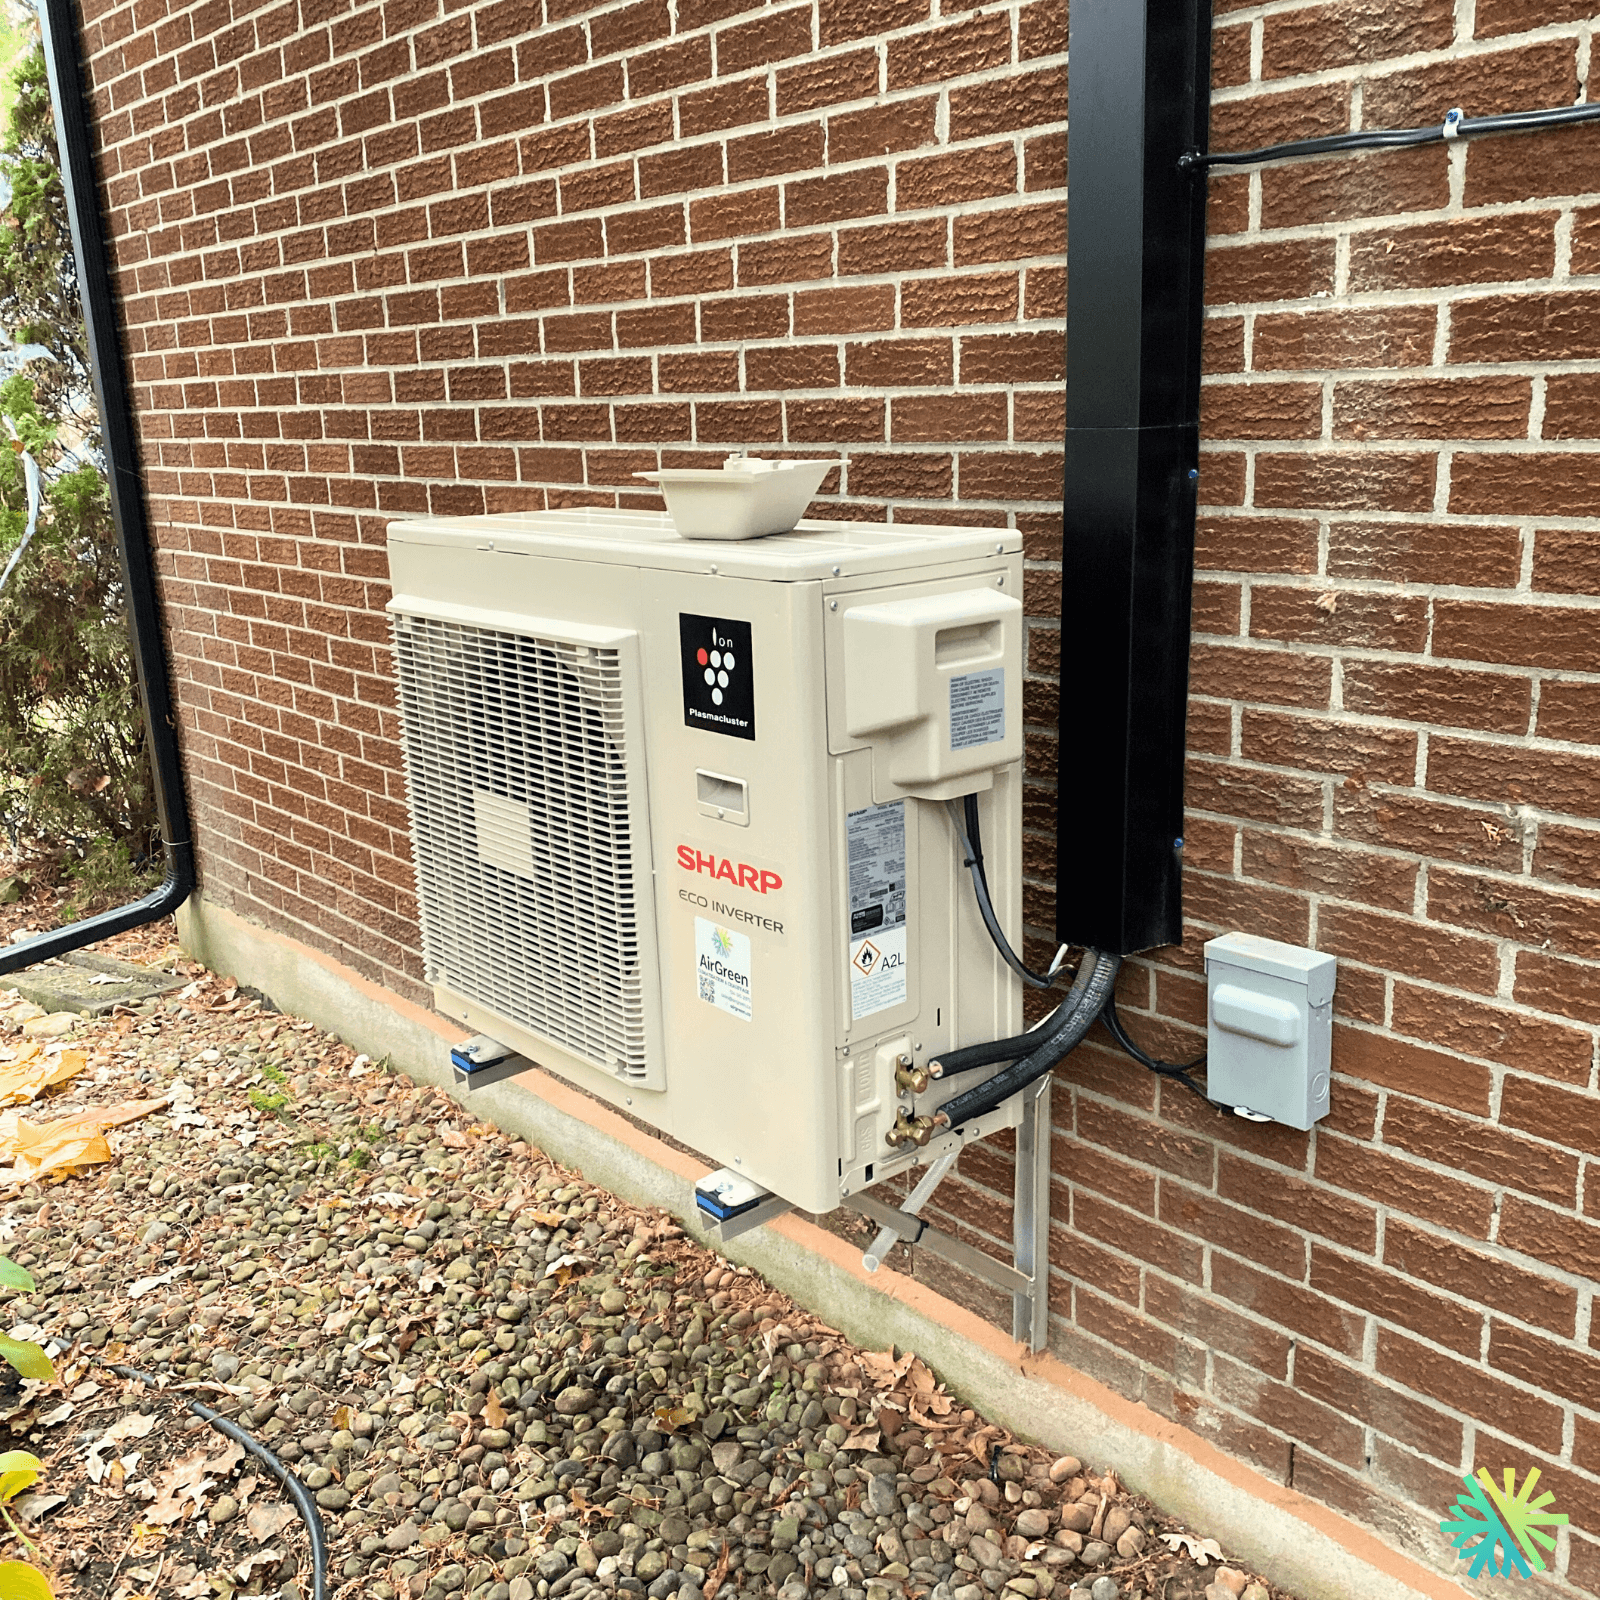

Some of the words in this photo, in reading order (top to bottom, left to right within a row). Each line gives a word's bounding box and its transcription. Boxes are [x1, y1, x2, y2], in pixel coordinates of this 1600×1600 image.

[712, 627, 734, 648] Ion
[689, 708, 749, 727] Plasmacluster
[677, 845, 783, 894] SHARP
[679, 889, 708, 908] ECO
[712, 900, 784, 934] INVERTER
[700, 954, 748, 987] AirGreen
[881, 952, 905, 971] A2L
